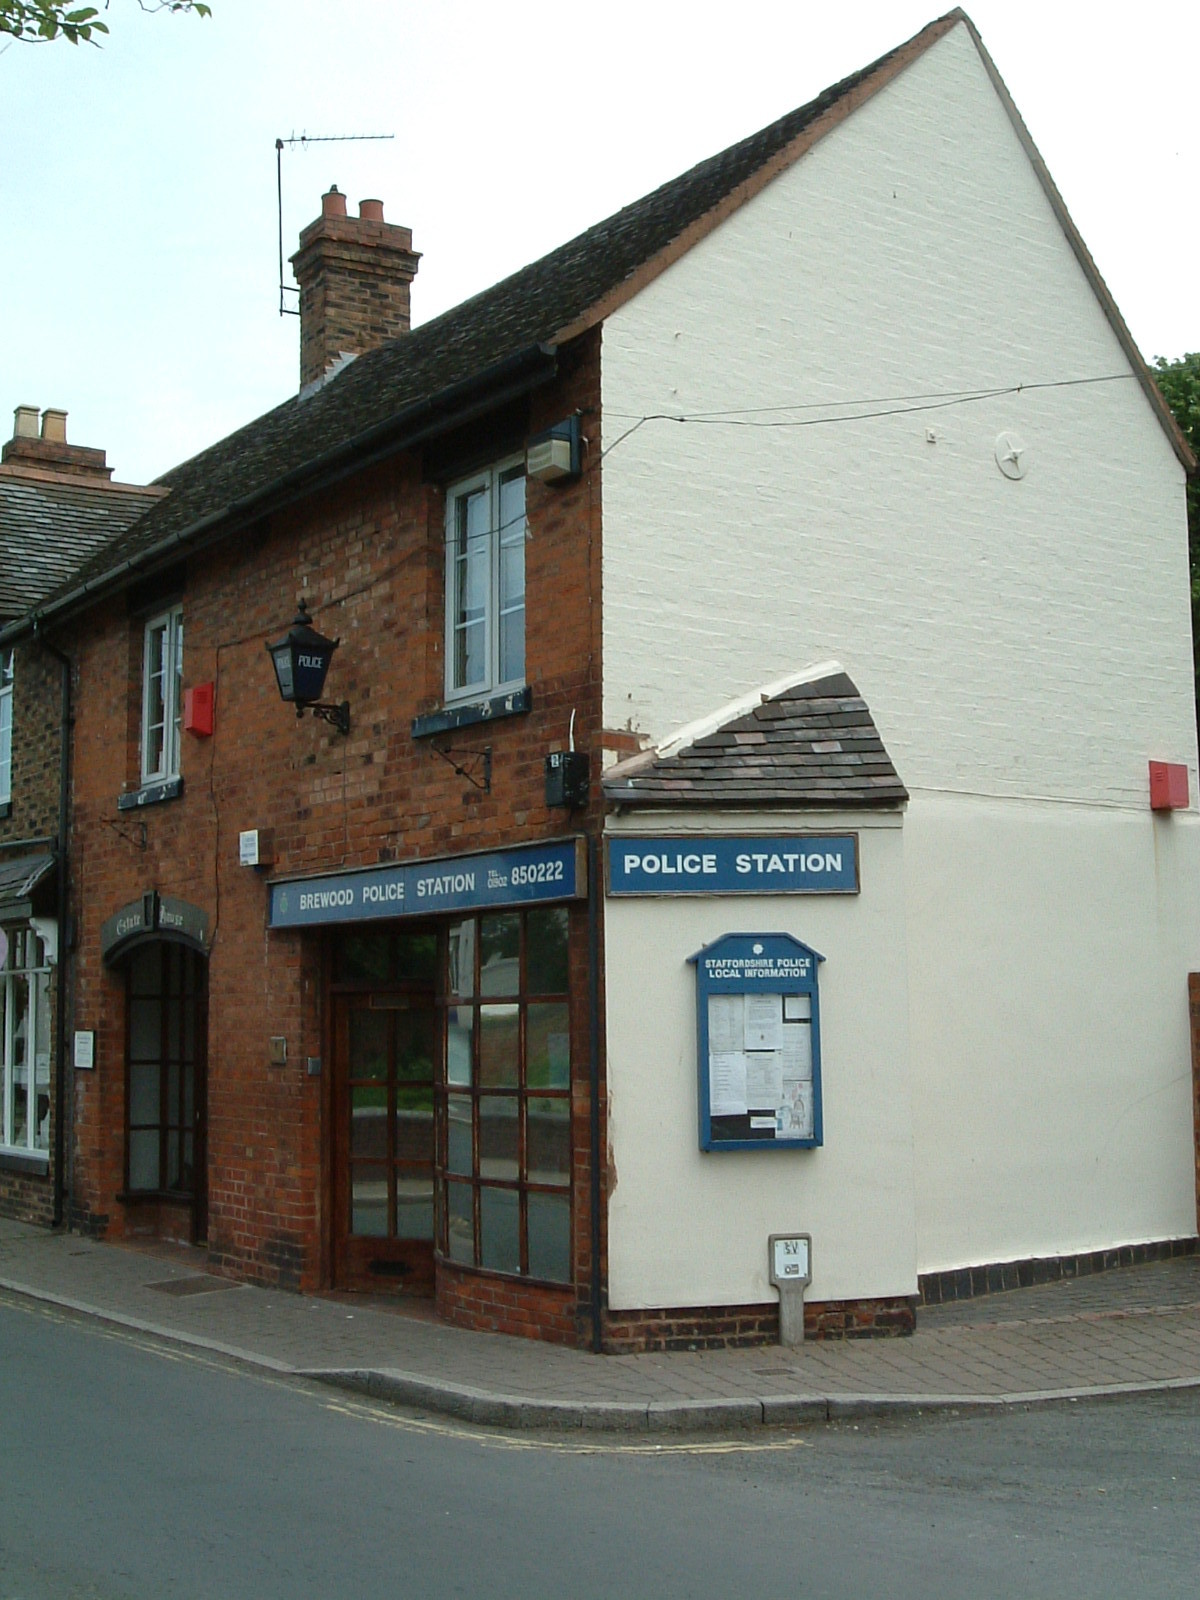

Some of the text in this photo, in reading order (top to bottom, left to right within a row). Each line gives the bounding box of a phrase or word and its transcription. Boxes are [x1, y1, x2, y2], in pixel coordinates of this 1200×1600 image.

[298, 655, 323, 669] POLICE
[623, 853, 842, 874] POLICE STATION
[511, 860, 563, 885] 850222
[299, 873, 475, 910] BREWOOD POLICE STATION
[705, 958, 811, 968] STAFFORDSHIRE POLICE
[709, 968, 807, 978] LOCAL INFORMATION
